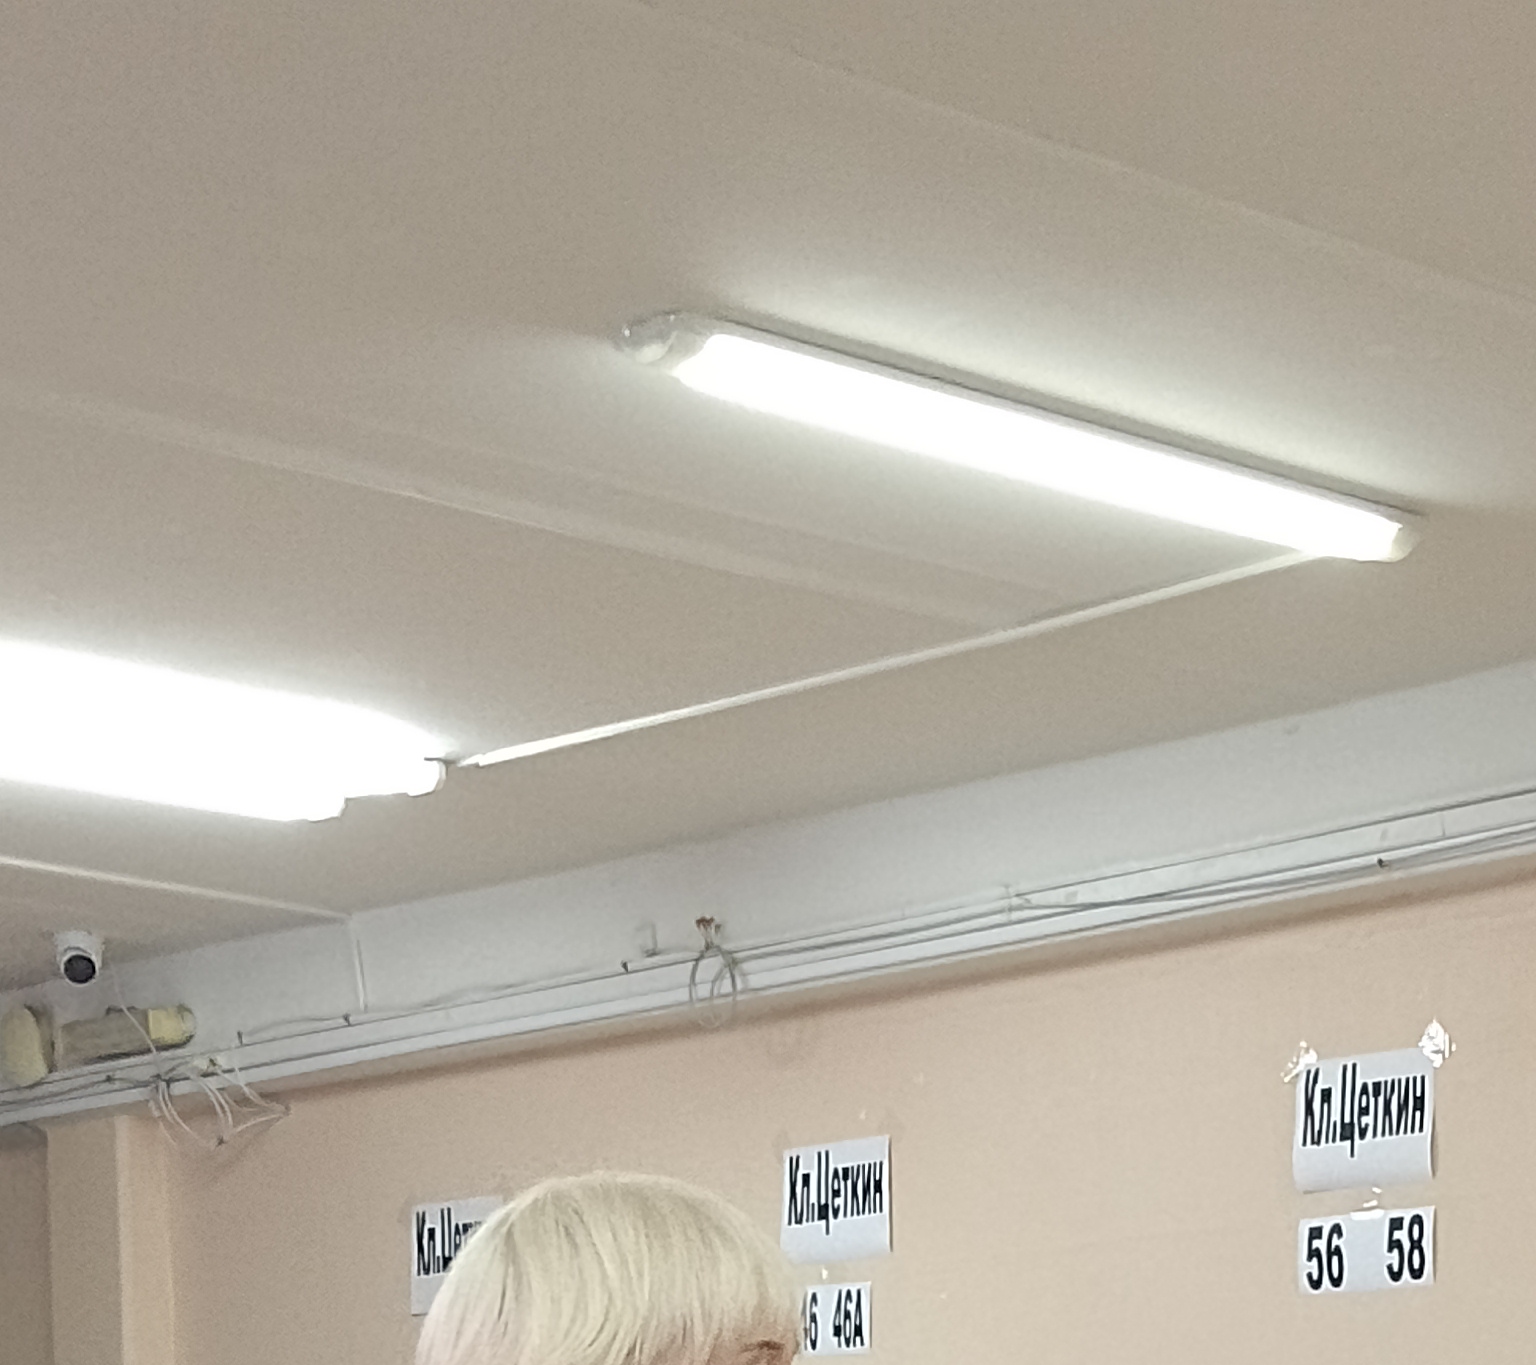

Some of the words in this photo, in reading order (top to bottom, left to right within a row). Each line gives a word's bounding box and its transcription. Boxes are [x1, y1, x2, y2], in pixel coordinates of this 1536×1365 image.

[1302, 1062, 1426, 1158] Кл.Цеткин
[787, 1150, 884, 1236] Кл.Цеткин
[415, 1206, 482, 1277] Кл.Це
[1306, 1222, 1345, 1291] 56
[1386, 1213, 1426, 1282] 58
[833, 1288, 865, 1348] 46А
